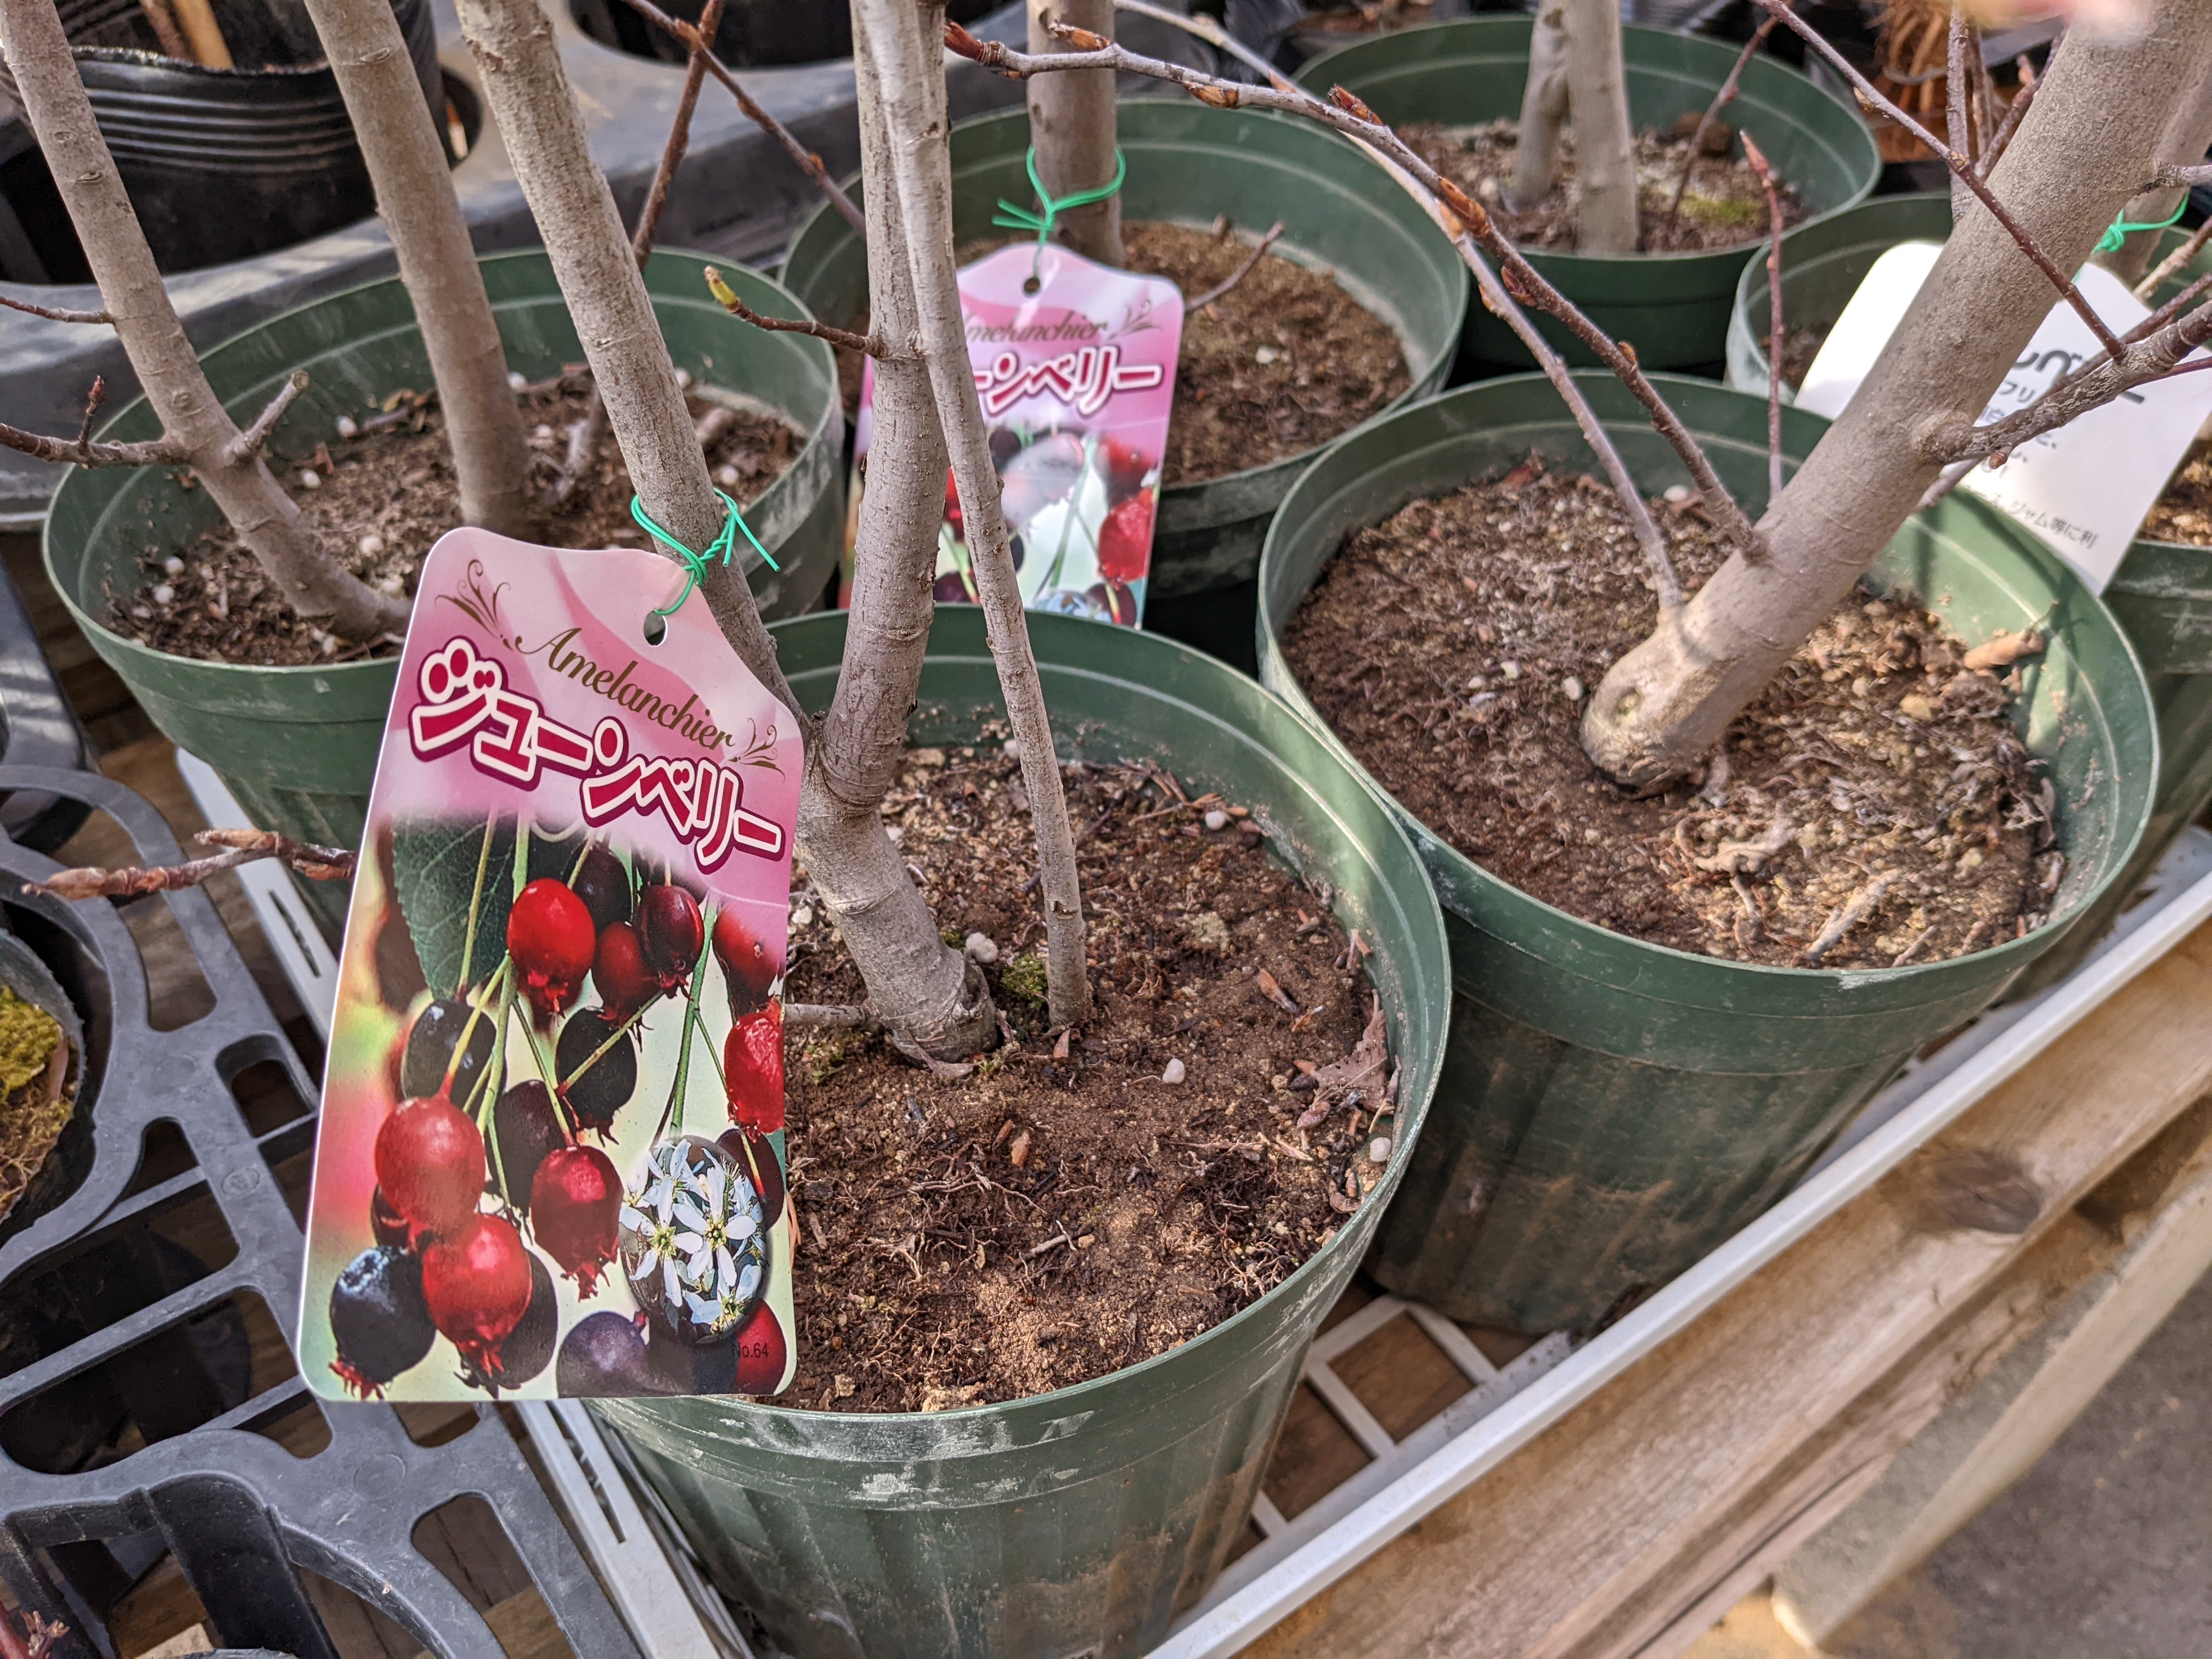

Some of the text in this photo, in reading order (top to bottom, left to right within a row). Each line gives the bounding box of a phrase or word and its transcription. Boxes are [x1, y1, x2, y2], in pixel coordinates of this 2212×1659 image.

[965, 310, 1109, 343] melanchier
[515, 627, 735, 751] Amelanchier
[410, 636, 785, 871] ジューンベリー
[731, 1341, 769, 1358] No.64
